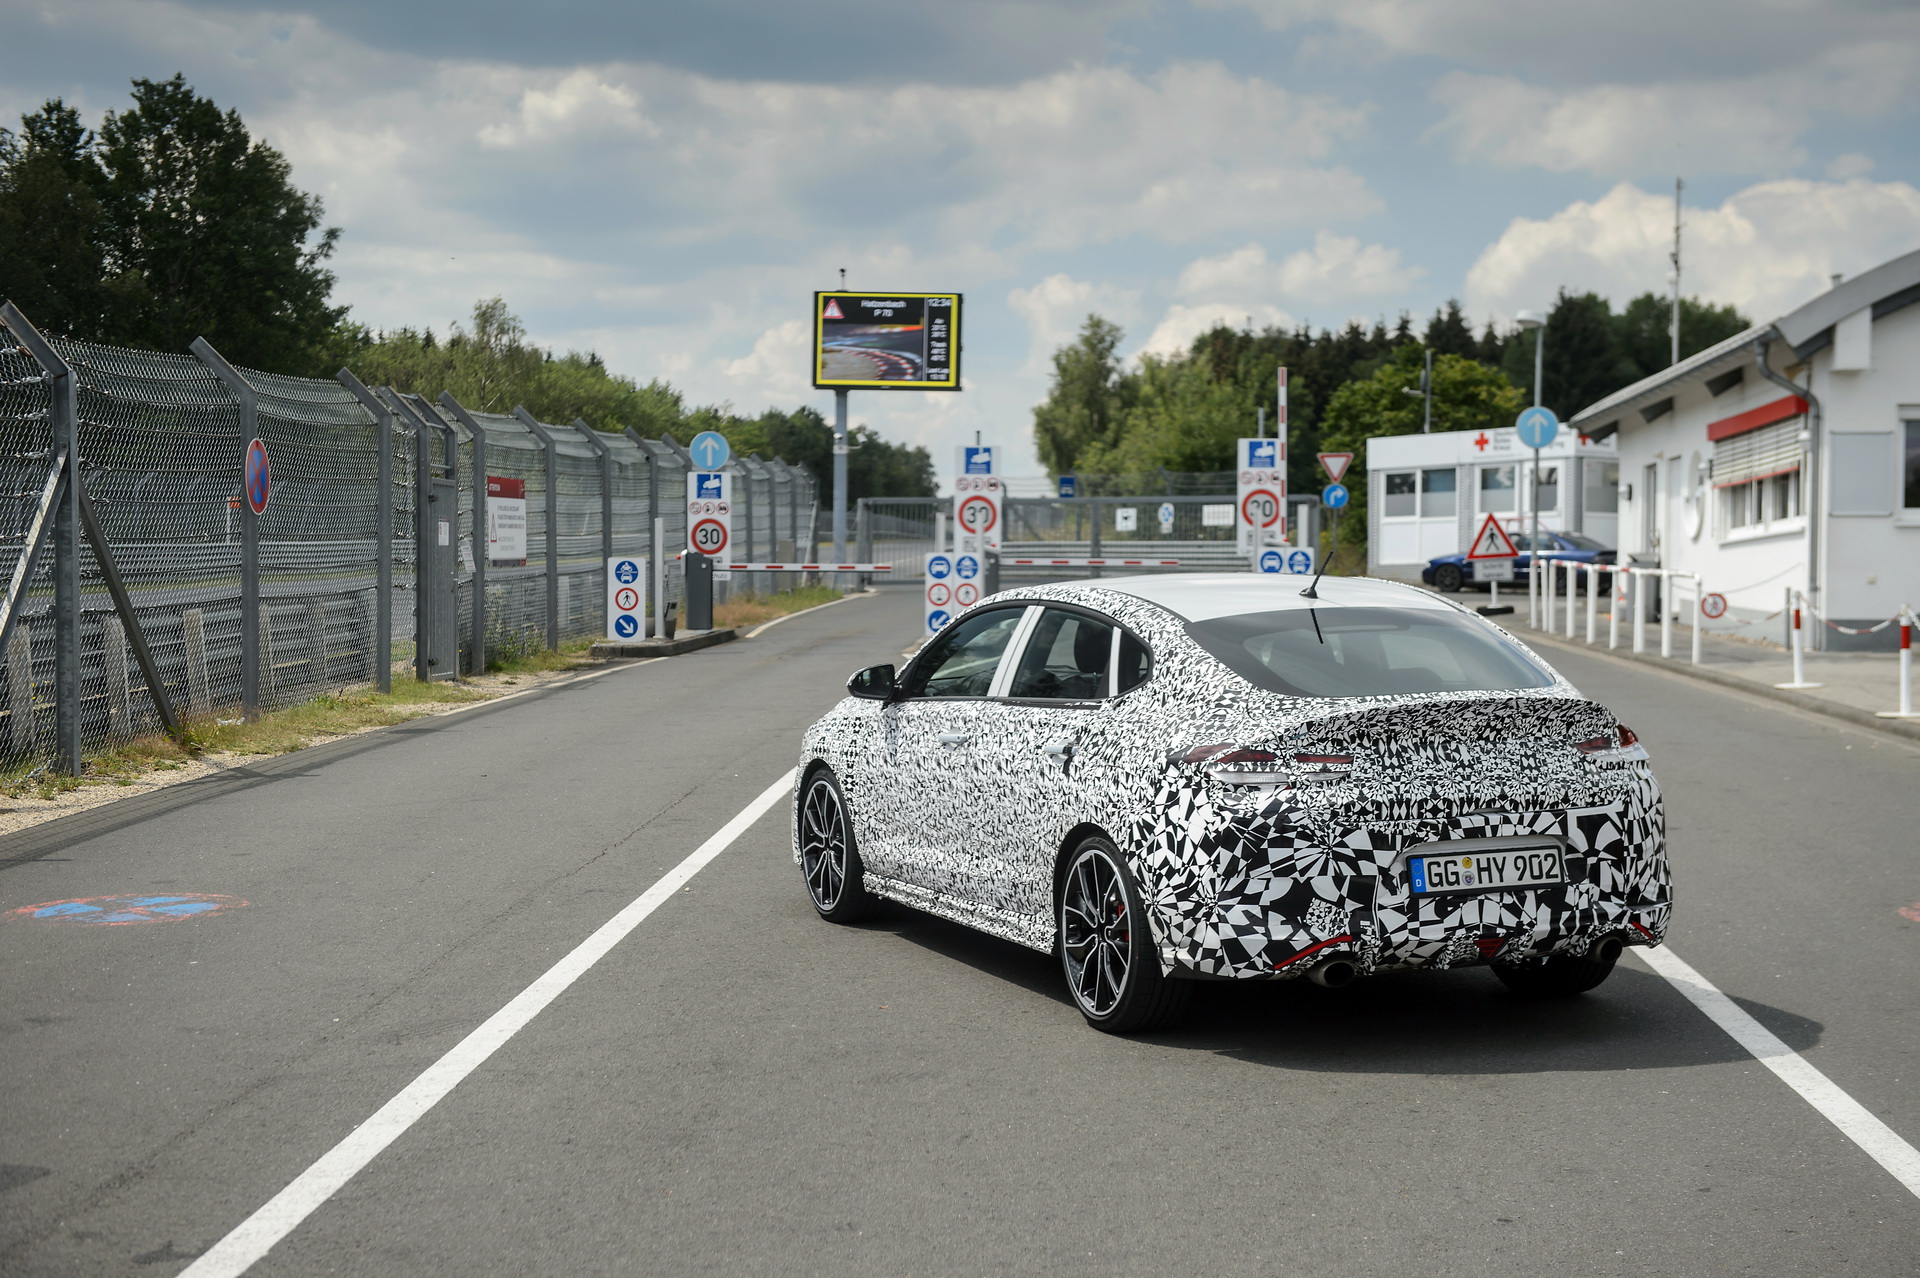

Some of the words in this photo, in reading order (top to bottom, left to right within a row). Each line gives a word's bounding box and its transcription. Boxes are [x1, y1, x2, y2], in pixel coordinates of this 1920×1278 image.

[966, 506, 989, 524] 30
[699, 528, 720, 544] 30
[1427, 861, 1460, 887] GG
[1476, 856, 1506, 884] HY
[1513, 853, 1559, 881] 902
[1415, 879, 1422, 887] D
